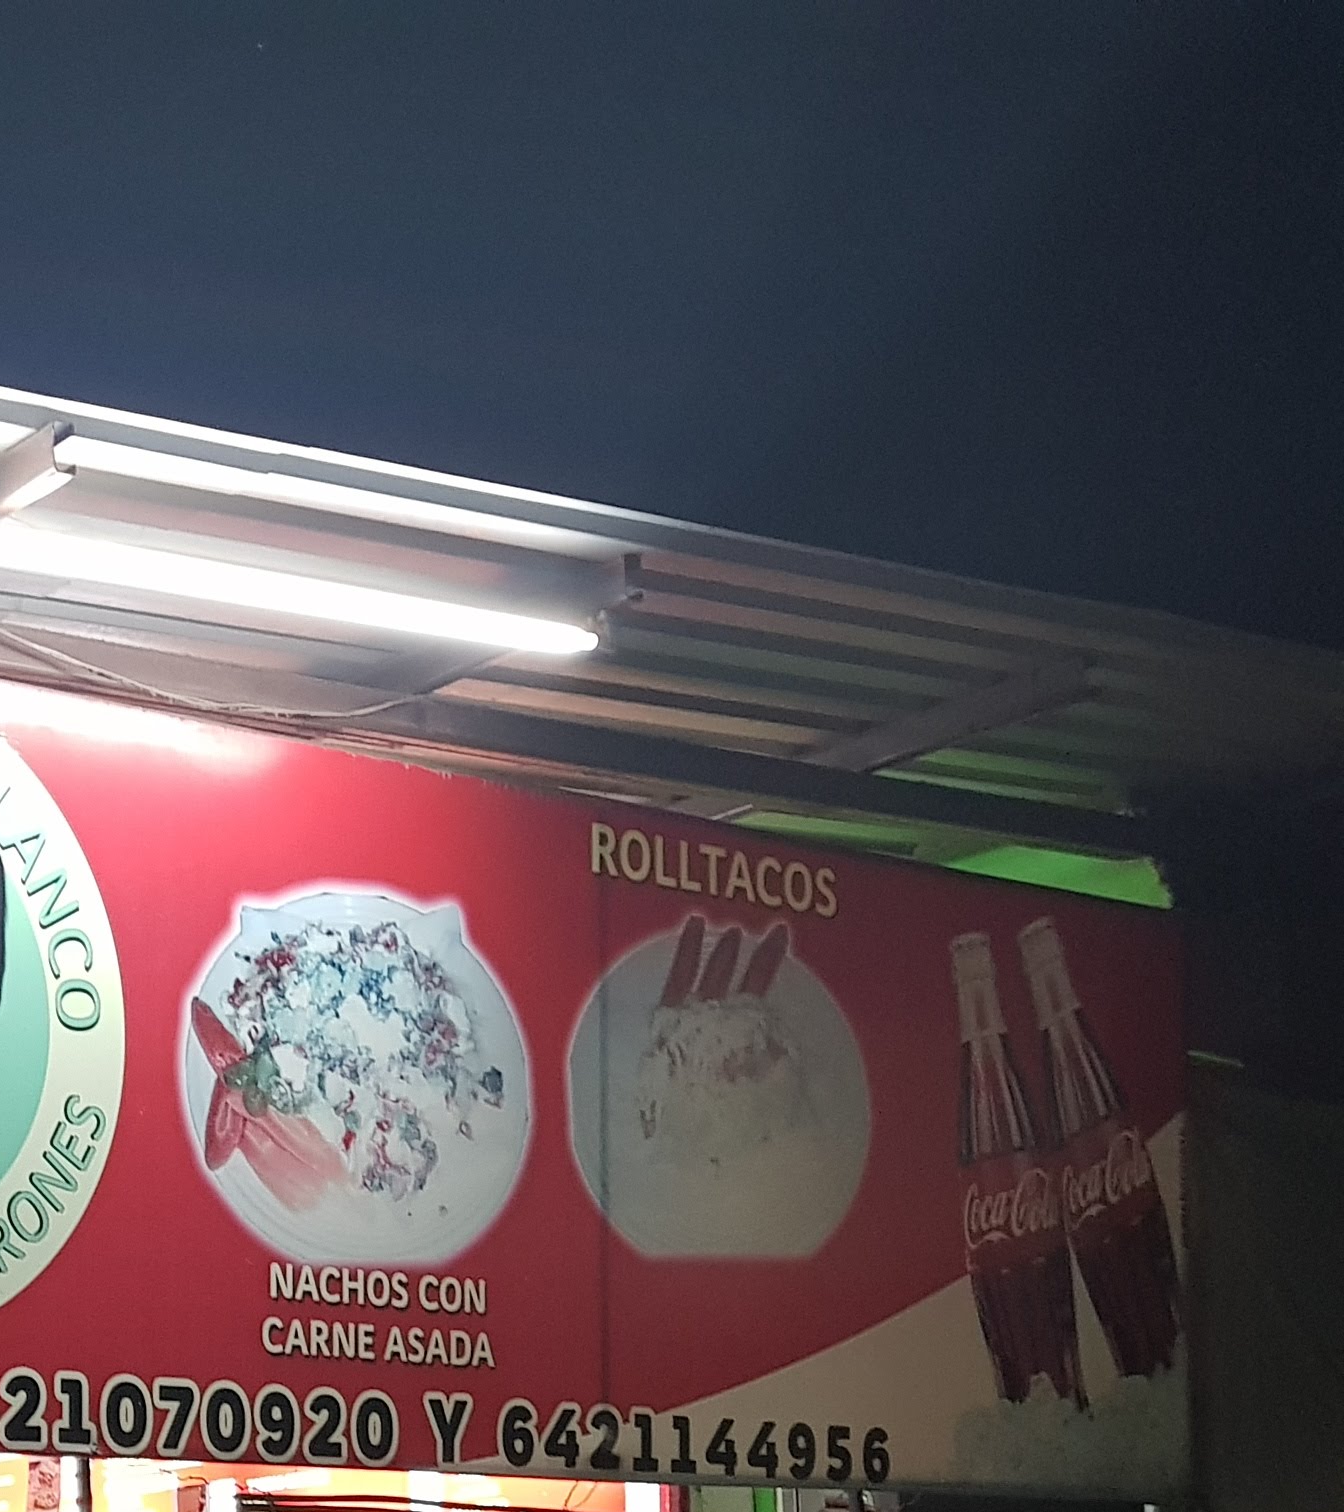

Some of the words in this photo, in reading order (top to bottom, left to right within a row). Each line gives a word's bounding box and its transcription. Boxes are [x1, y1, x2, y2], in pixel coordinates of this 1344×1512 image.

[589, 823, 839, 918] ROLLTACOS
[268, 1262, 409, 1308] NACHOS
[417, 1273, 488, 1316] CON
[261, 1317, 376, 1363] CARNE
[384, 1327, 495, 1369] ASADA
[425, 1393, 474, 1466] Y
[498, 1401, 891, 1485] 6421144956
